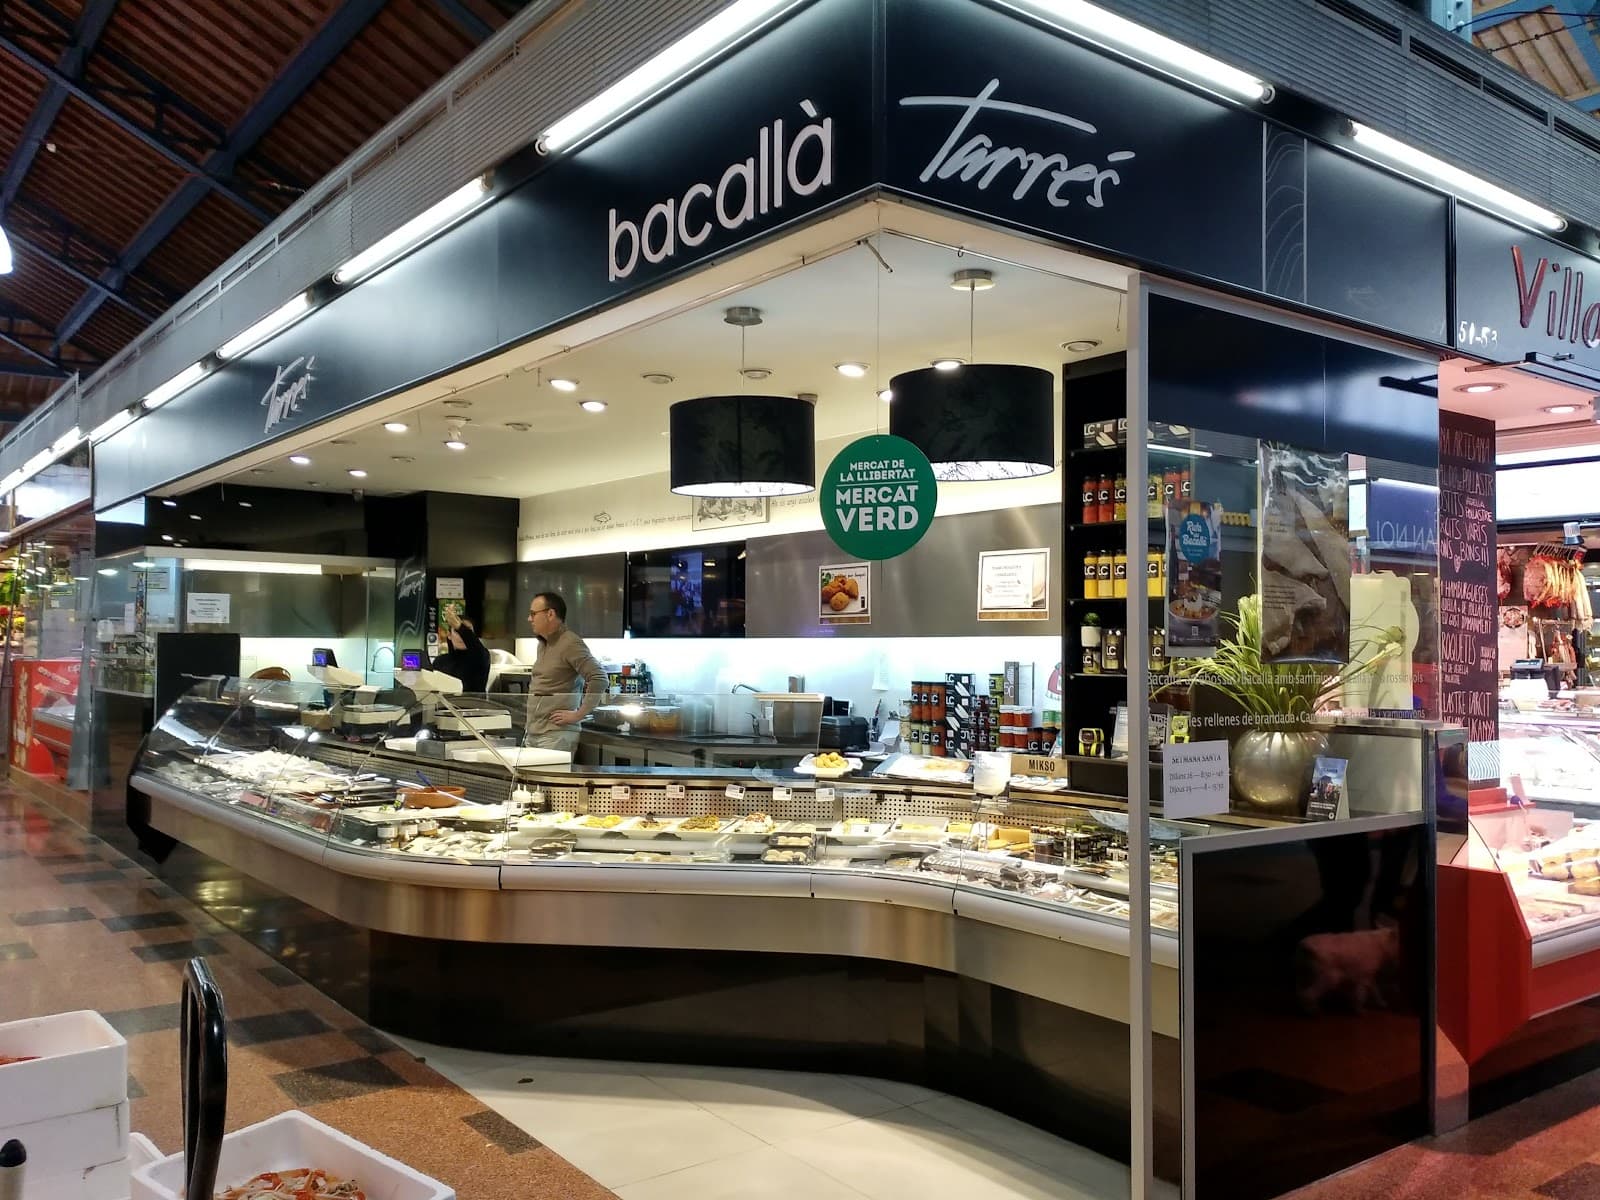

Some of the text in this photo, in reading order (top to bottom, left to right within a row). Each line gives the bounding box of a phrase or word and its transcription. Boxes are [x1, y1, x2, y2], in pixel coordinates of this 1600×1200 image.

[608, 78, 1136, 282] bacallà Tarrés
[850, 459, 905, 471] MERCAT DE
[840, 469, 915, 482] LA LLIBERTAT
[836, 485, 918, 505] MERCAT
[836, 505, 918, 532] VERD
[1204, 712, 1241, 727] rellenes
[1242, 711, 1254, 725] de
[1255, 711, 1296, 725] brandada
[1029, 759, 1055, 772] MIKSO
